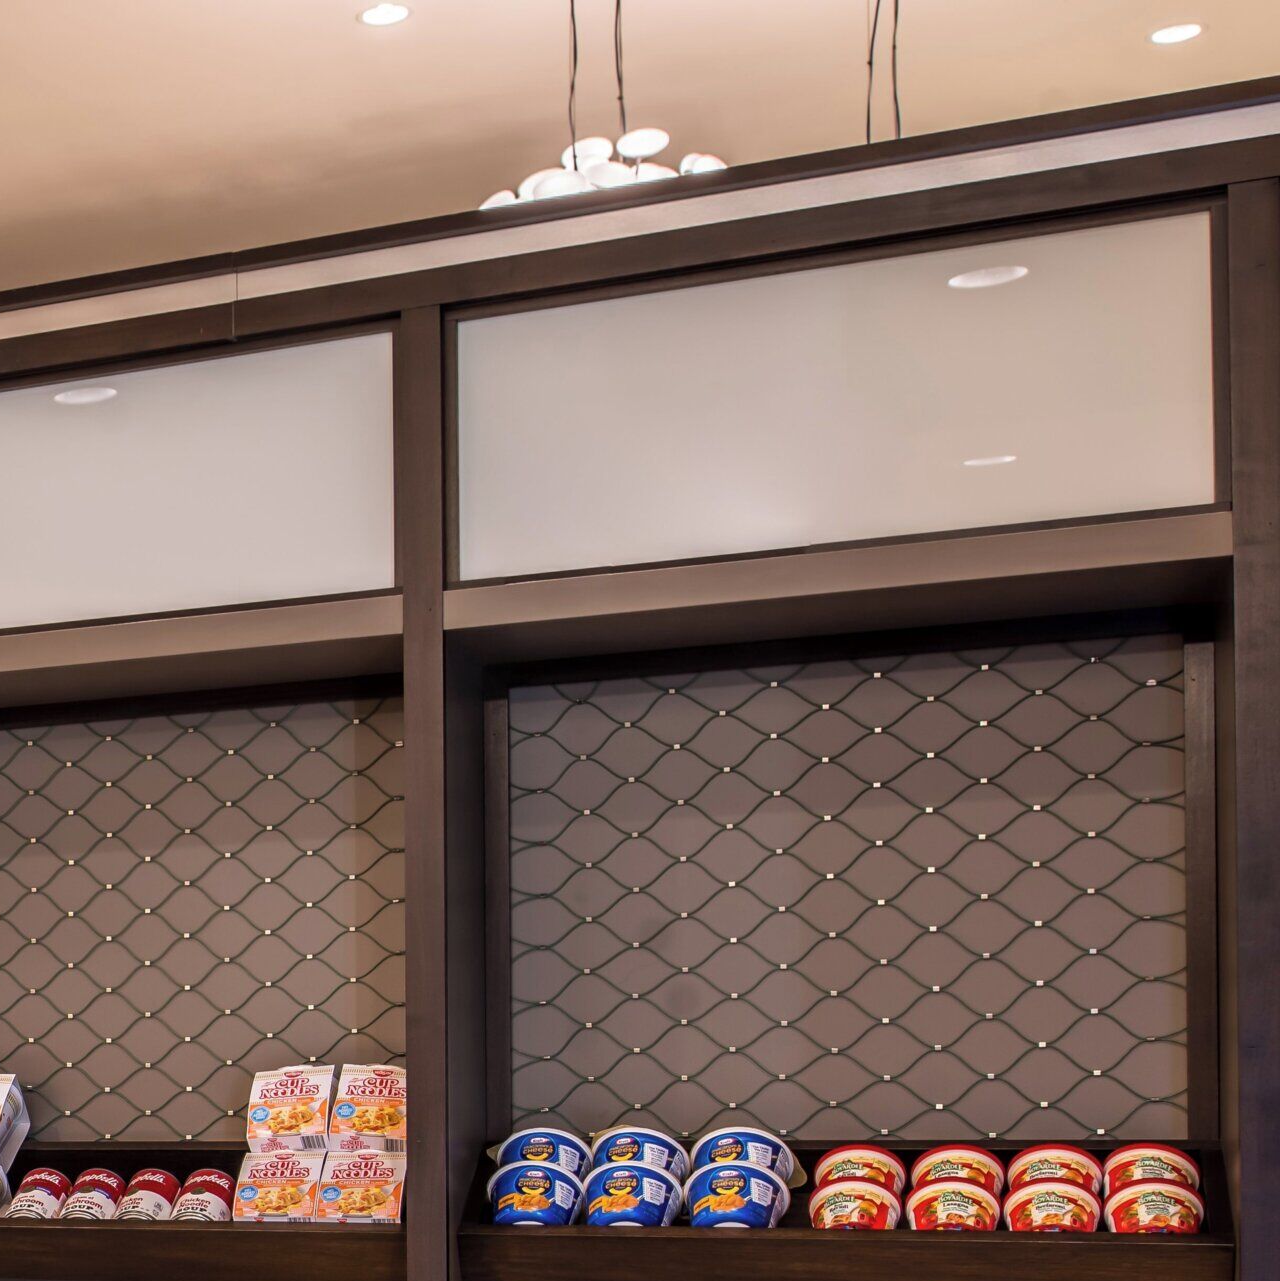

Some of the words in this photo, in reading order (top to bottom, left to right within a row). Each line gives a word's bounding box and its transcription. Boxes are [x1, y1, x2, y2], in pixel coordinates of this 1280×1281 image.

[275, 1078, 309, 1088] CUP
[363, 1077, 399, 1087] CUP
[259, 1085, 320, 1099] NOODLES
[346, 1085, 407, 1098] NOODLES
[265, 1160, 300, 1170] CUP
[348, 1161, 385, 1170] CUP
[248, 1168, 310, 1179] NOODLES
[331, 1168, 394, 1179] NOODLES
